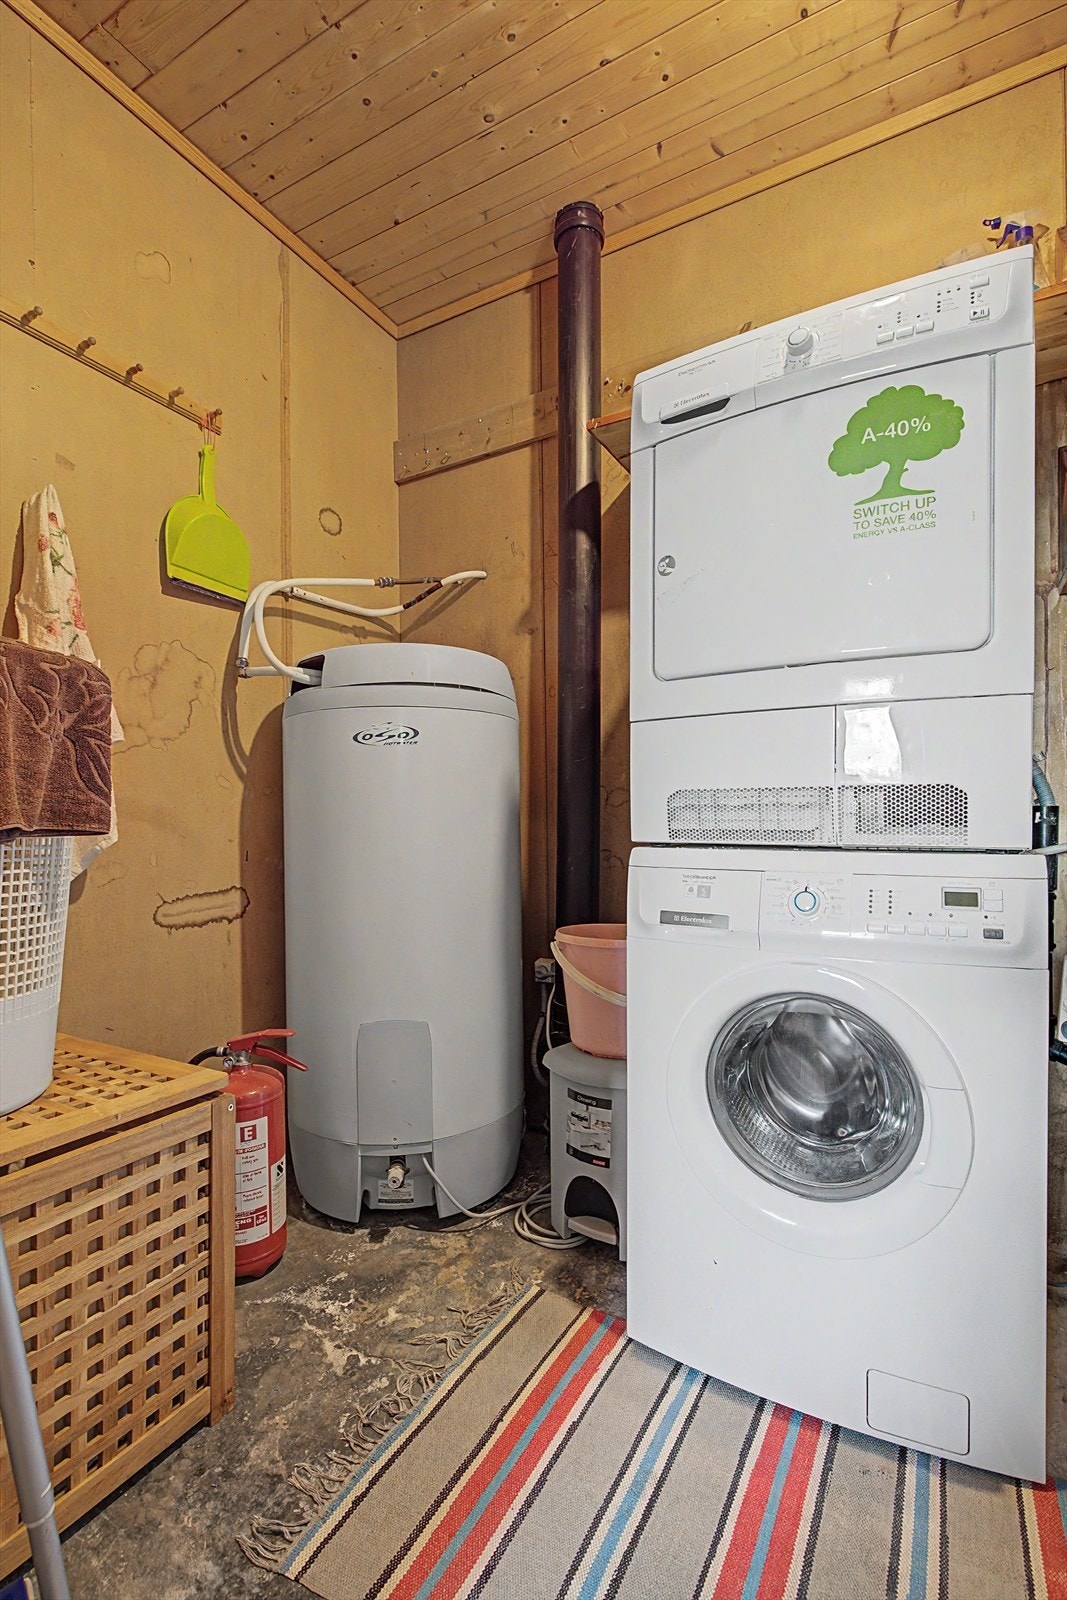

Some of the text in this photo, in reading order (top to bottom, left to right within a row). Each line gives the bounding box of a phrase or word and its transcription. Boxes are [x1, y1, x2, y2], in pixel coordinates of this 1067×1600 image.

[861, 416, 931, 445] A-40%
[853, 496, 937, 520] SWITCH UP
[853, 509, 937, 531] TO SAVE 40%
[853, 521, 936, 540] ENERGY VS A-CLASS
[680, 915, 713, 924] Electrolux
[244, 1127, 253, 1141] E
